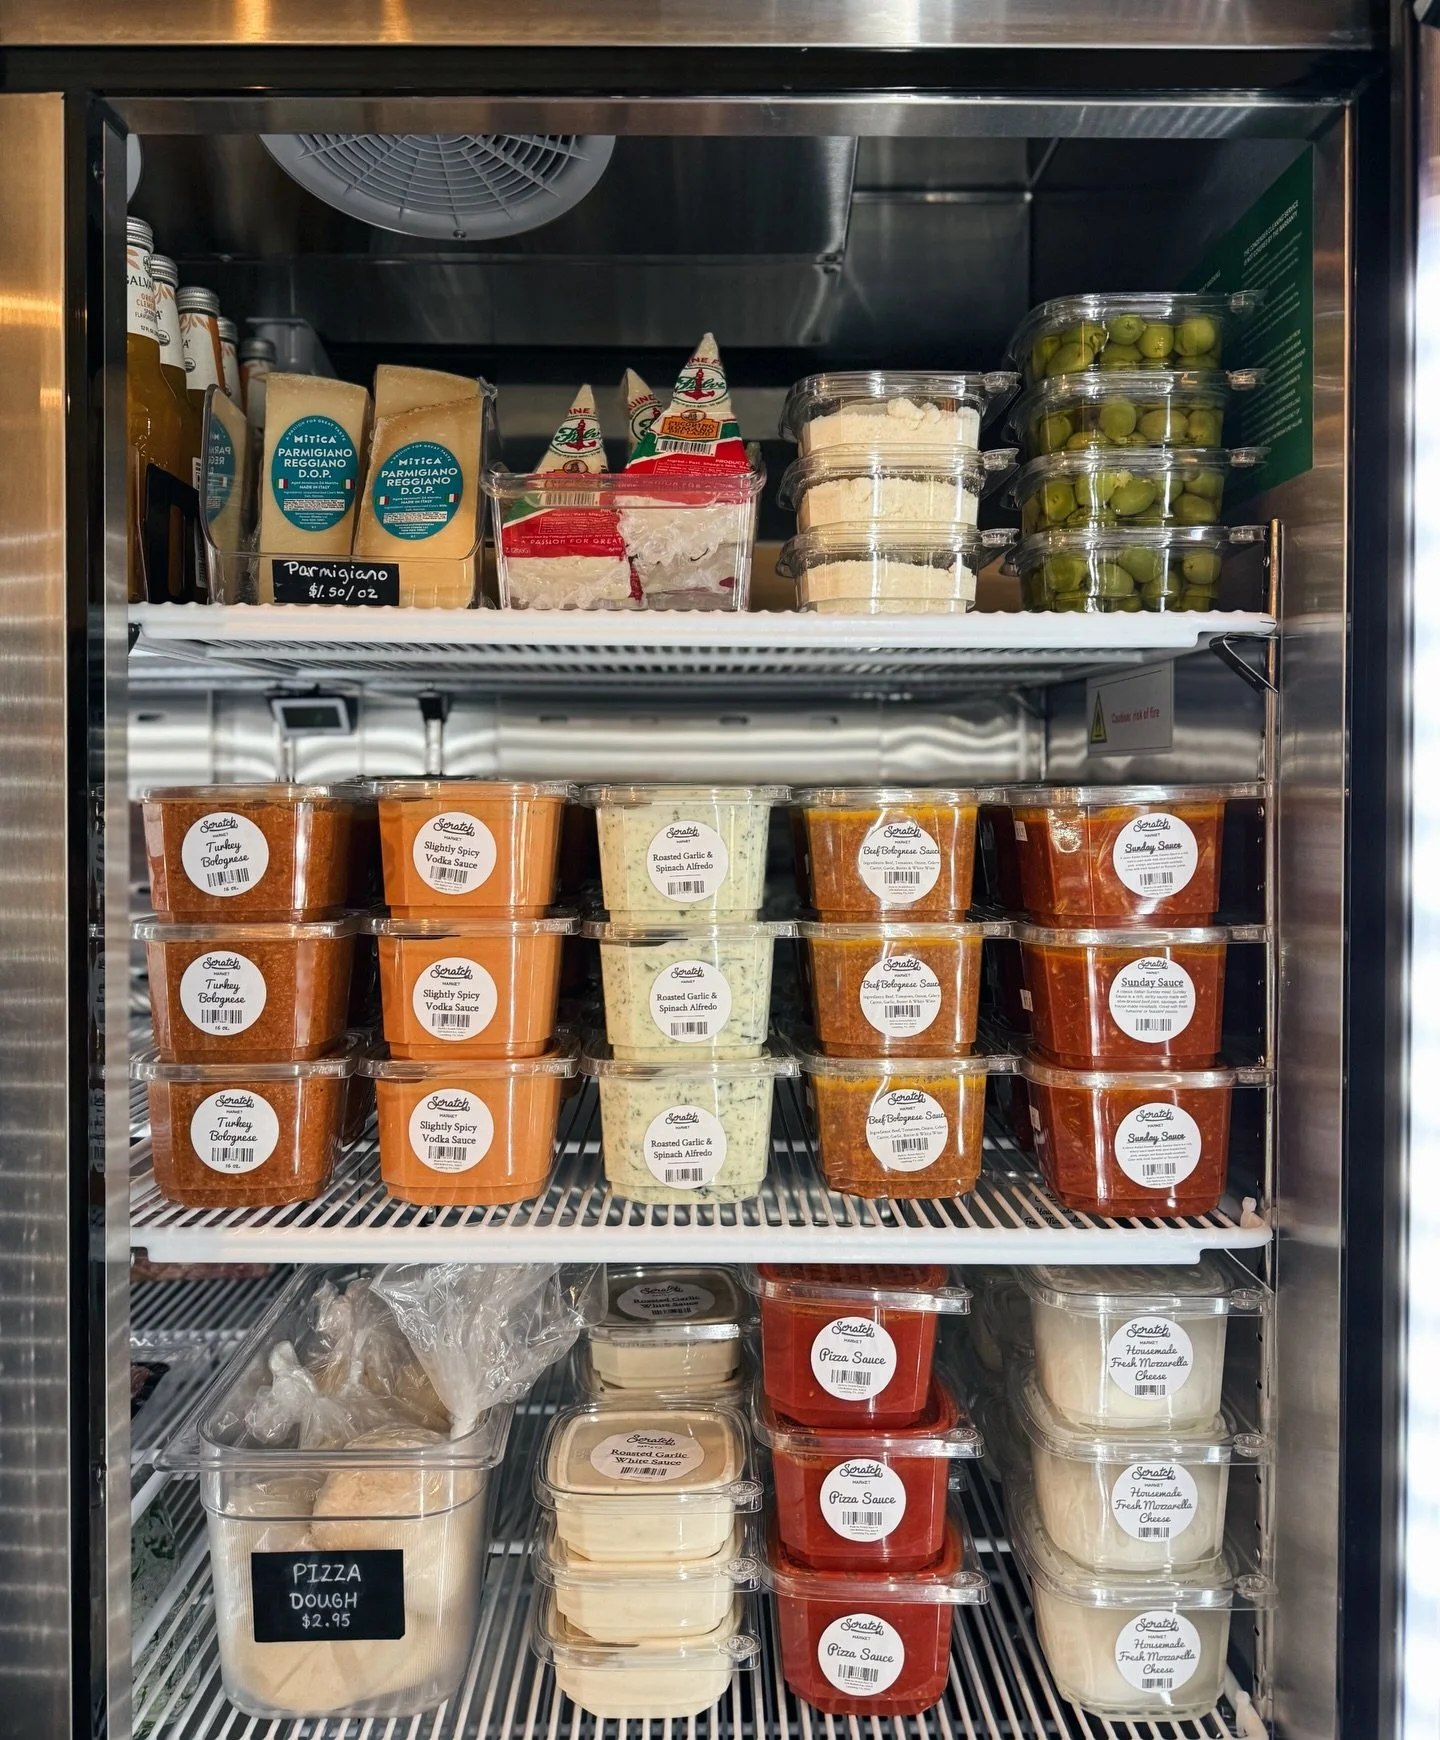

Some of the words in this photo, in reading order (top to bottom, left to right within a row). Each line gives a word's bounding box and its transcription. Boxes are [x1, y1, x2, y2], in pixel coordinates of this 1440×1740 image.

[318, 419, 334, 427] GREAT
[278, 448, 352, 457] PARMIGIANO
[284, 459, 346, 468] REGGIANO
[299, 470, 332, 478] D.O.P.
[381, 468, 457, 478] PARMIGIANO
[387, 477, 450, 486] REGGIANO
[401, 487, 435, 495] D.O.P.
[283, 561, 388, 585] Parmigiano
[1133, 710, 1142, 721] risk
[1143, 707, 1149, 719] of
[1150, 706, 1160, 719] fire
[200, 817, 238, 833] Scratch
[433, 818, 475, 837] Scratch
[1133, 818, 1171, 832] Scratch
[666, 826, 699, 838] Scratch
[884, 825, 921, 838] Scratch
[206, 839, 242, 853] Turkey
[424, 841, 456, 855] Slightly
[457, 846, 480, 858] Spicy
[863, 846, 881, 857] Beef
[881, 846, 918, 858] Bolognese
[1125, 842, 1157, 854] Sunday
[1158, 841, 1182, 851] Sauce
[201, 854, 249, 869] Bolognese
[426, 854, 452, 865] Vodka
[453, 859, 478, 869] Sauce
[653, 853, 682, 861] Roasted
[683, 852, 706, 860] Garlic
[656, 864, 685, 874] Spinach
[686, 862, 713, 871] Alfredo
[203, 957, 241, 970] Scratch
[883, 959, 921, 971] Scratch
[1138, 960, 1168, 970] Scratch
[430, 965, 473, 980] Scratch
[671, 967, 704, 978] Scratch
[206, 979, 240, 994] Turkey
[863, 980, 881, 991] Beef
[880, 979, 918, 992] Bolognese
[1121, 978, 1156, 988] Sunday
[1158, 978, 1184, 987] Sauce
[198, 992, 246, 1008] Bolognese
[423, 990, 455, 1000] Slightly
[457, 991, 480, 1001] Spicy
[657, 993, 685, 1001] Roasted
[426, 1002, 452, 1011] Vodka
[455, 1004, 479, 1012] Sauce
[659, 1004, 688, 1014] Spinach
[689, 1003, 717, 1011] Alfredo
[215, 1095, 254, 1108] Scratch
[427, 1096, 470, 1112] Scratch
[888, 1091, 926, 1105] Scratch
[665, 1112, 699, 1124] Scratch
[866, 1114, 887, 1125] Beef
[886, 1113, 923, 1125] Bolognese
[1136, 1109, 1174, 1122] Scratch
[218, 1117, 253, 1132] Turkey
[420, 1121, 453, 1132] Slightly
[454, 1123, 477, 1133] Spicy
[209, 1130, 258, 1146] Bolognese
[422, 1134, 450, 1143] Vodka
[452, 1136, 476, 1144] Sauce
[651, 1139, 680, 1147] Roasted
[682, 1138, 704, 1146] Garlic
[1127, 1132, 1159, 1145] Sunday
[1161, 1132, 1186, 1141] Sauce
[653, 1151, 683, 1160] Spinach
[685, 1149, 712, 1157] Alfredo
[832, 1321, 875, 1338] Scratch
[1126, 1324, 1171, 1338] Scratch
[1126, 1344, 1178, 1355] Housemade
[820, 1348, 849, 1362] Pizza
[852, 1351, 886, 1365] Sauce
[1110, 1357, 1137, 1368] Fresh
[1139, 1356, 1189, 1367] Mozzarella
[1135, 1370, 1167, 1381] Cheese
[627, 1434, 676, 1446] Scratch
[610, 1449, 653, 1457] Roasted
[840, 1464, 883, 1478] Scratch
[1132, 1466, 1176, 1481] Scratch
[829, 1491, 859, 1504] Pizza
[862, 1492, 896, 1504] Sauce
[1131, 1486, 1182, 1497] Housemade
[1114, 1499, 1142, 1510] Fresh
[1144, 1499, 1192, 1510] Mozzarella
[1139, 1512, 1171, 1523] Cheese
[293, 1563, 362, 1584] PIZZA
[289, 1592, 358, 1610] DOUGH
[302, 1613, 351, 1629] $2.95
[841, 1618, 884, 1635] Scratch
[1136, 1618, 1179, 1632] Scratch
[1134, 1638, 1185, 1649] Housemade
[827, 1643, 857, 1656] Pizza
[860, 1648, 894, 1663] Sauce
[1118, 1651, 1145, 1661] Fresh
[1147, 1649, 1196, 1661] Mozzarella
[1143, 1664, 1174, 1674] Cheese
